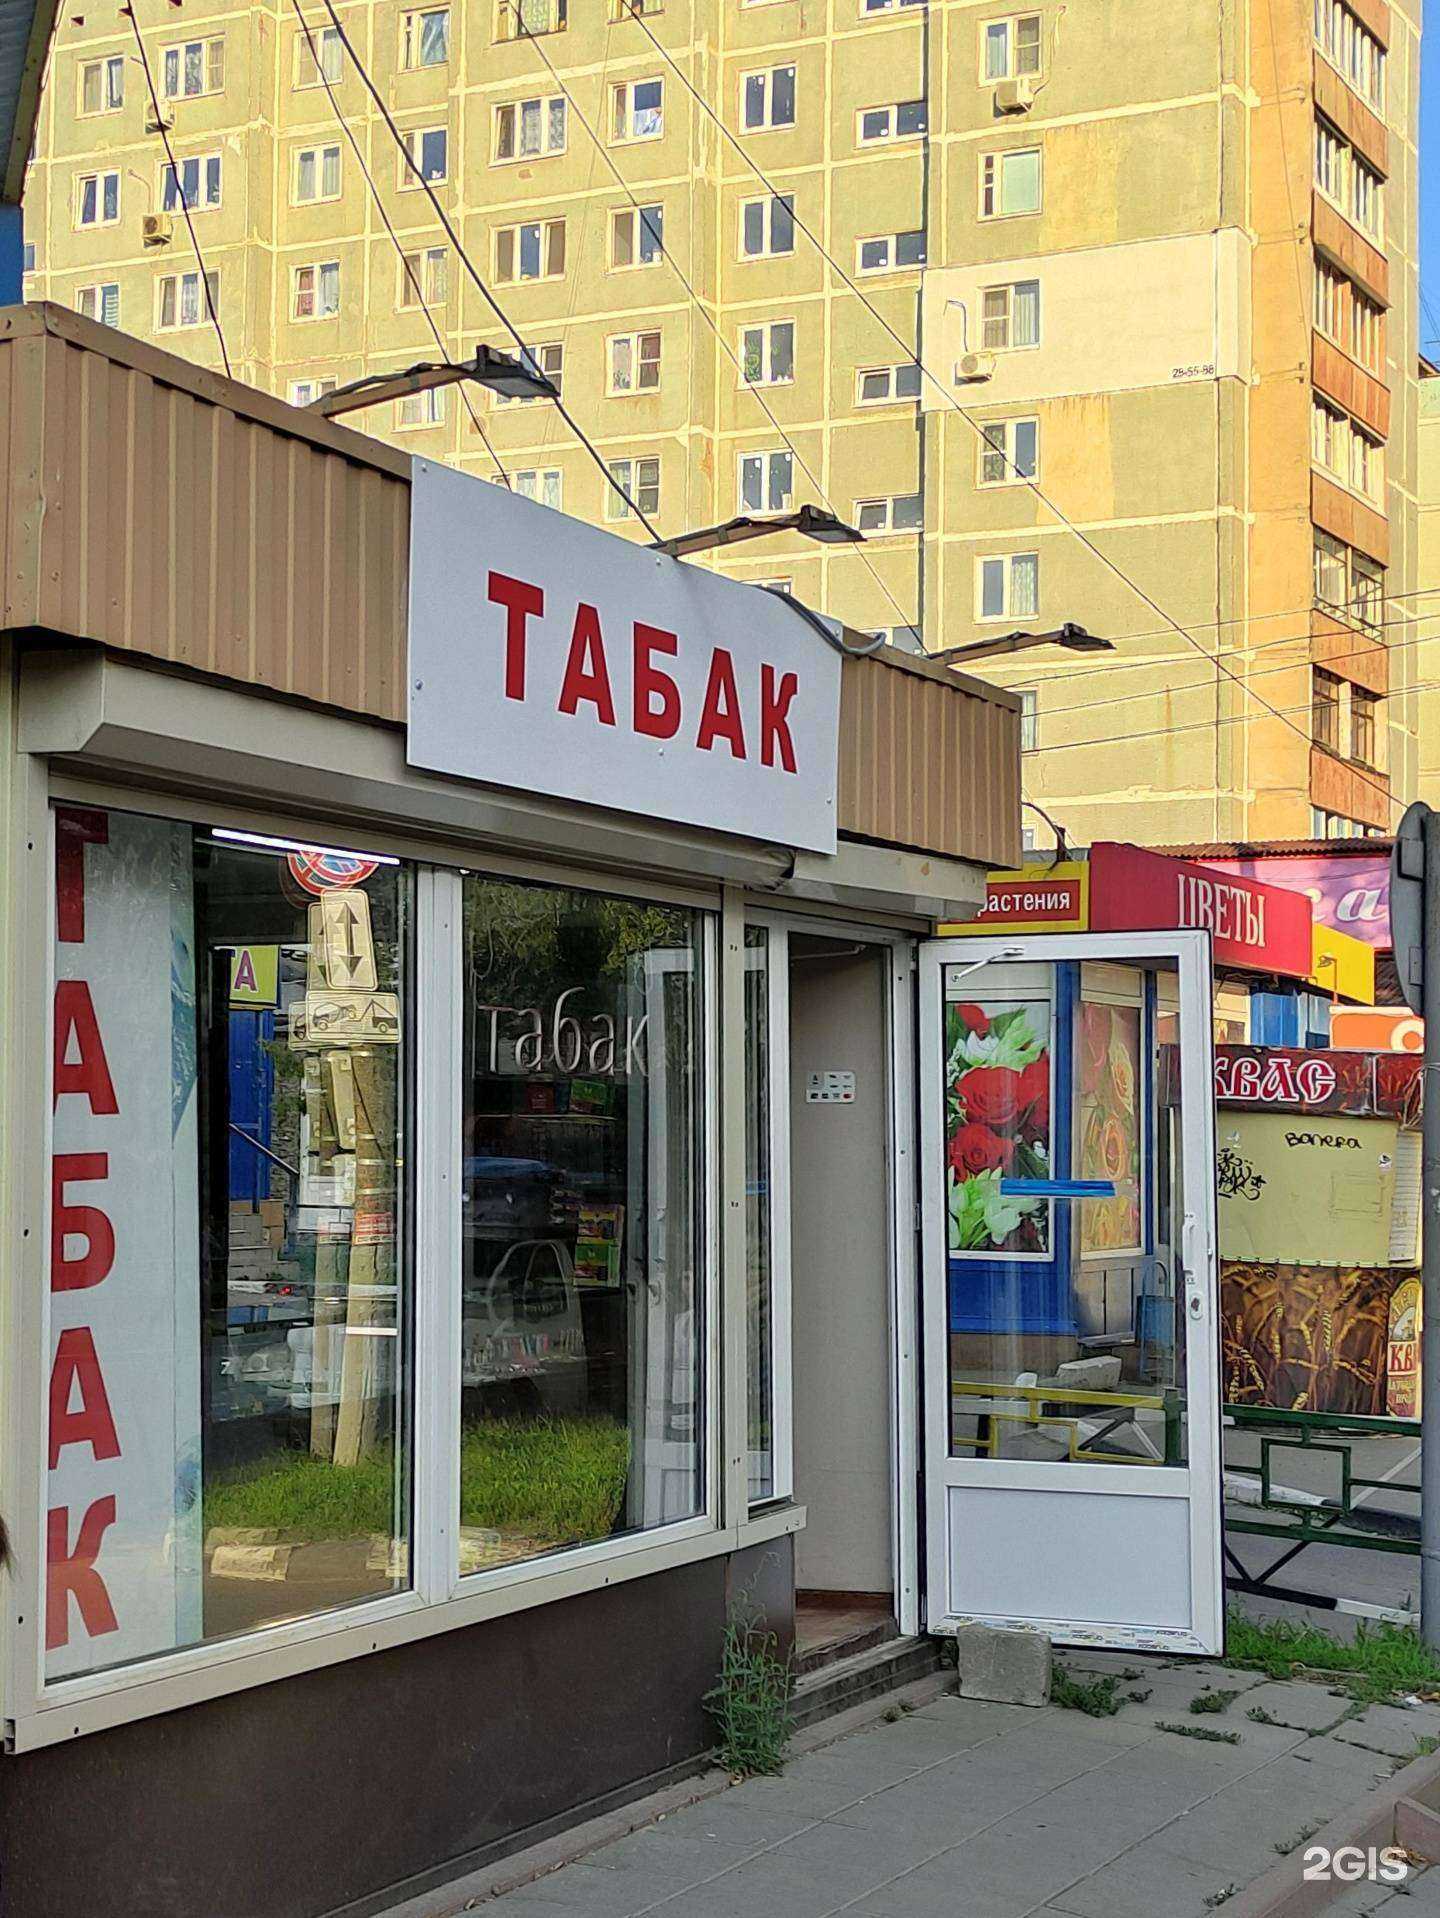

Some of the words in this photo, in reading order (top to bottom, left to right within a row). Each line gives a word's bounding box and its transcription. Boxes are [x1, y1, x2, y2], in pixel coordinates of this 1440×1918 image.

[487, 569, 798, 774] ТАБАК
[1177, 873, 1266, 948] ЦВЕТЫ
[44, 806, 119, 1651] ТАБАК
